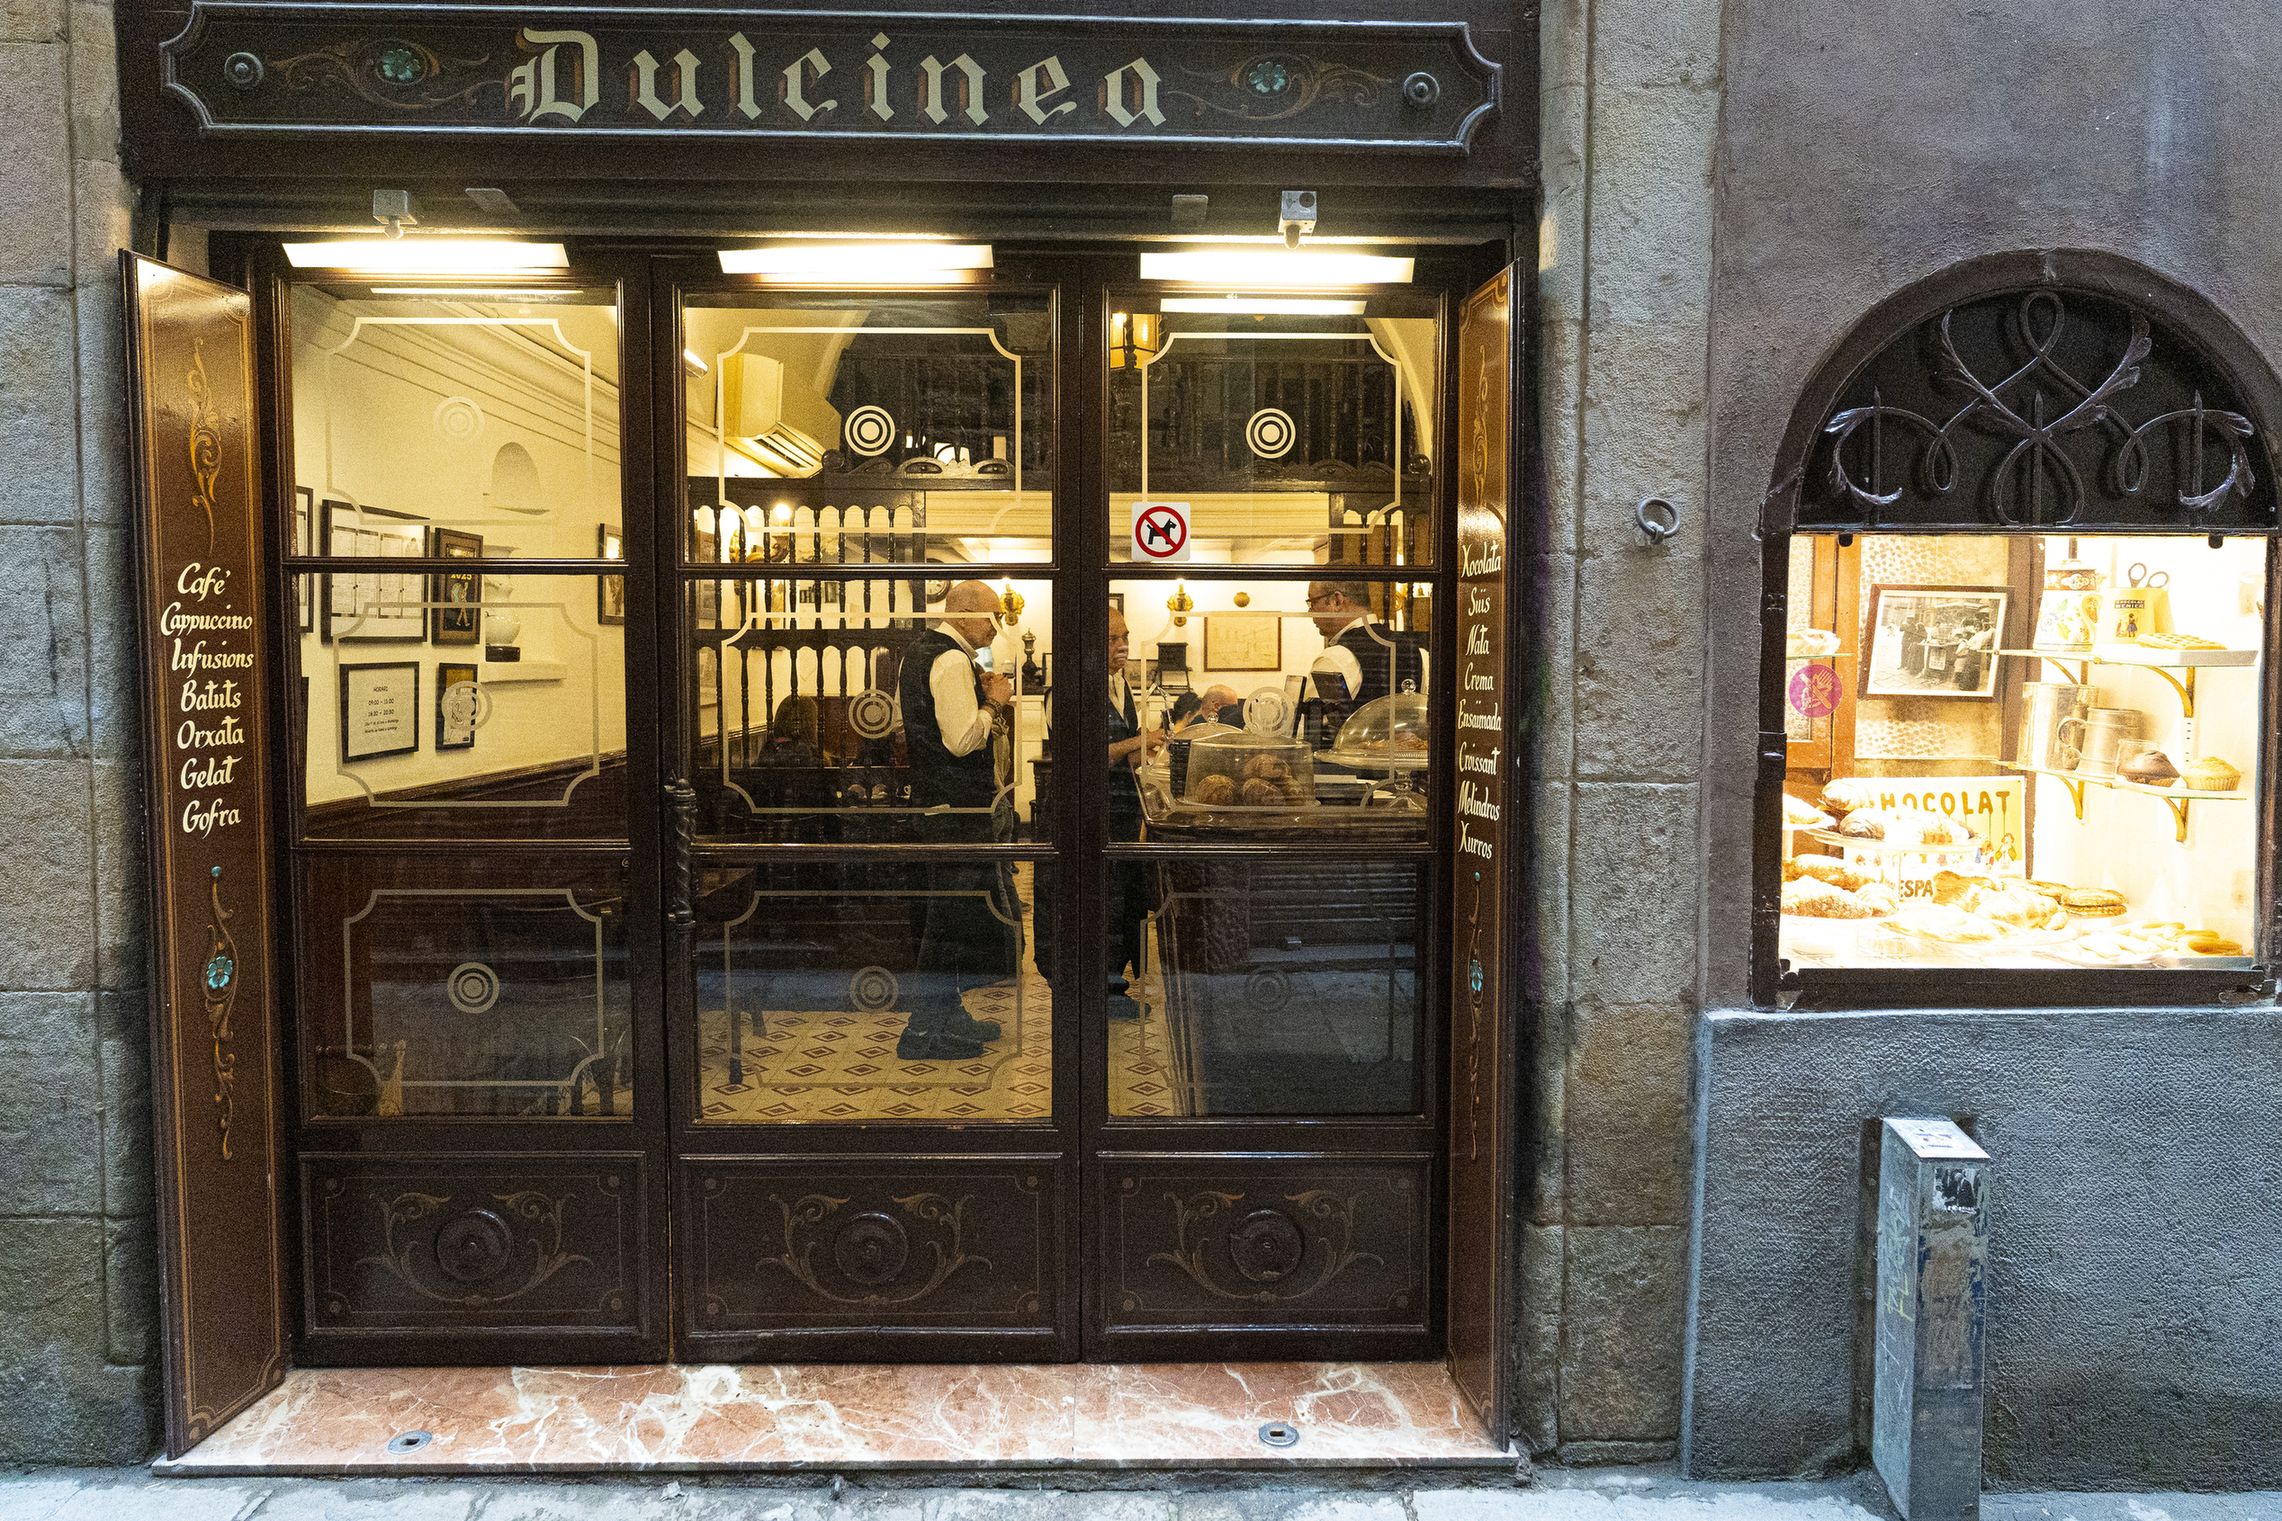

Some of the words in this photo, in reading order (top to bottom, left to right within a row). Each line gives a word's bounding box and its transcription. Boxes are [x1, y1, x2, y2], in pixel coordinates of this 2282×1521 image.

[509, 27, 1167, 128] Dulcinea
[1461, 540, 1502, 578] Xocolata
[160, 601, 253, 636] Cappuccino
[1465, 624, 1489, 656] Nata
[171, 637, 254, 679] Infusions
[1464, 661, 1494, 691] Crema
[180, 679, 241, 712] Batuts
[177, 715, 245, 750] Orxata
[180, 755, 243, 790] Gelat
[1459, 741, 1501, 776] Croissant
[1457, 780, 1500, 821] Melindros
[182, 798, 241, 840] Gofra
[1458, 820, 1493, 860] Xurros
